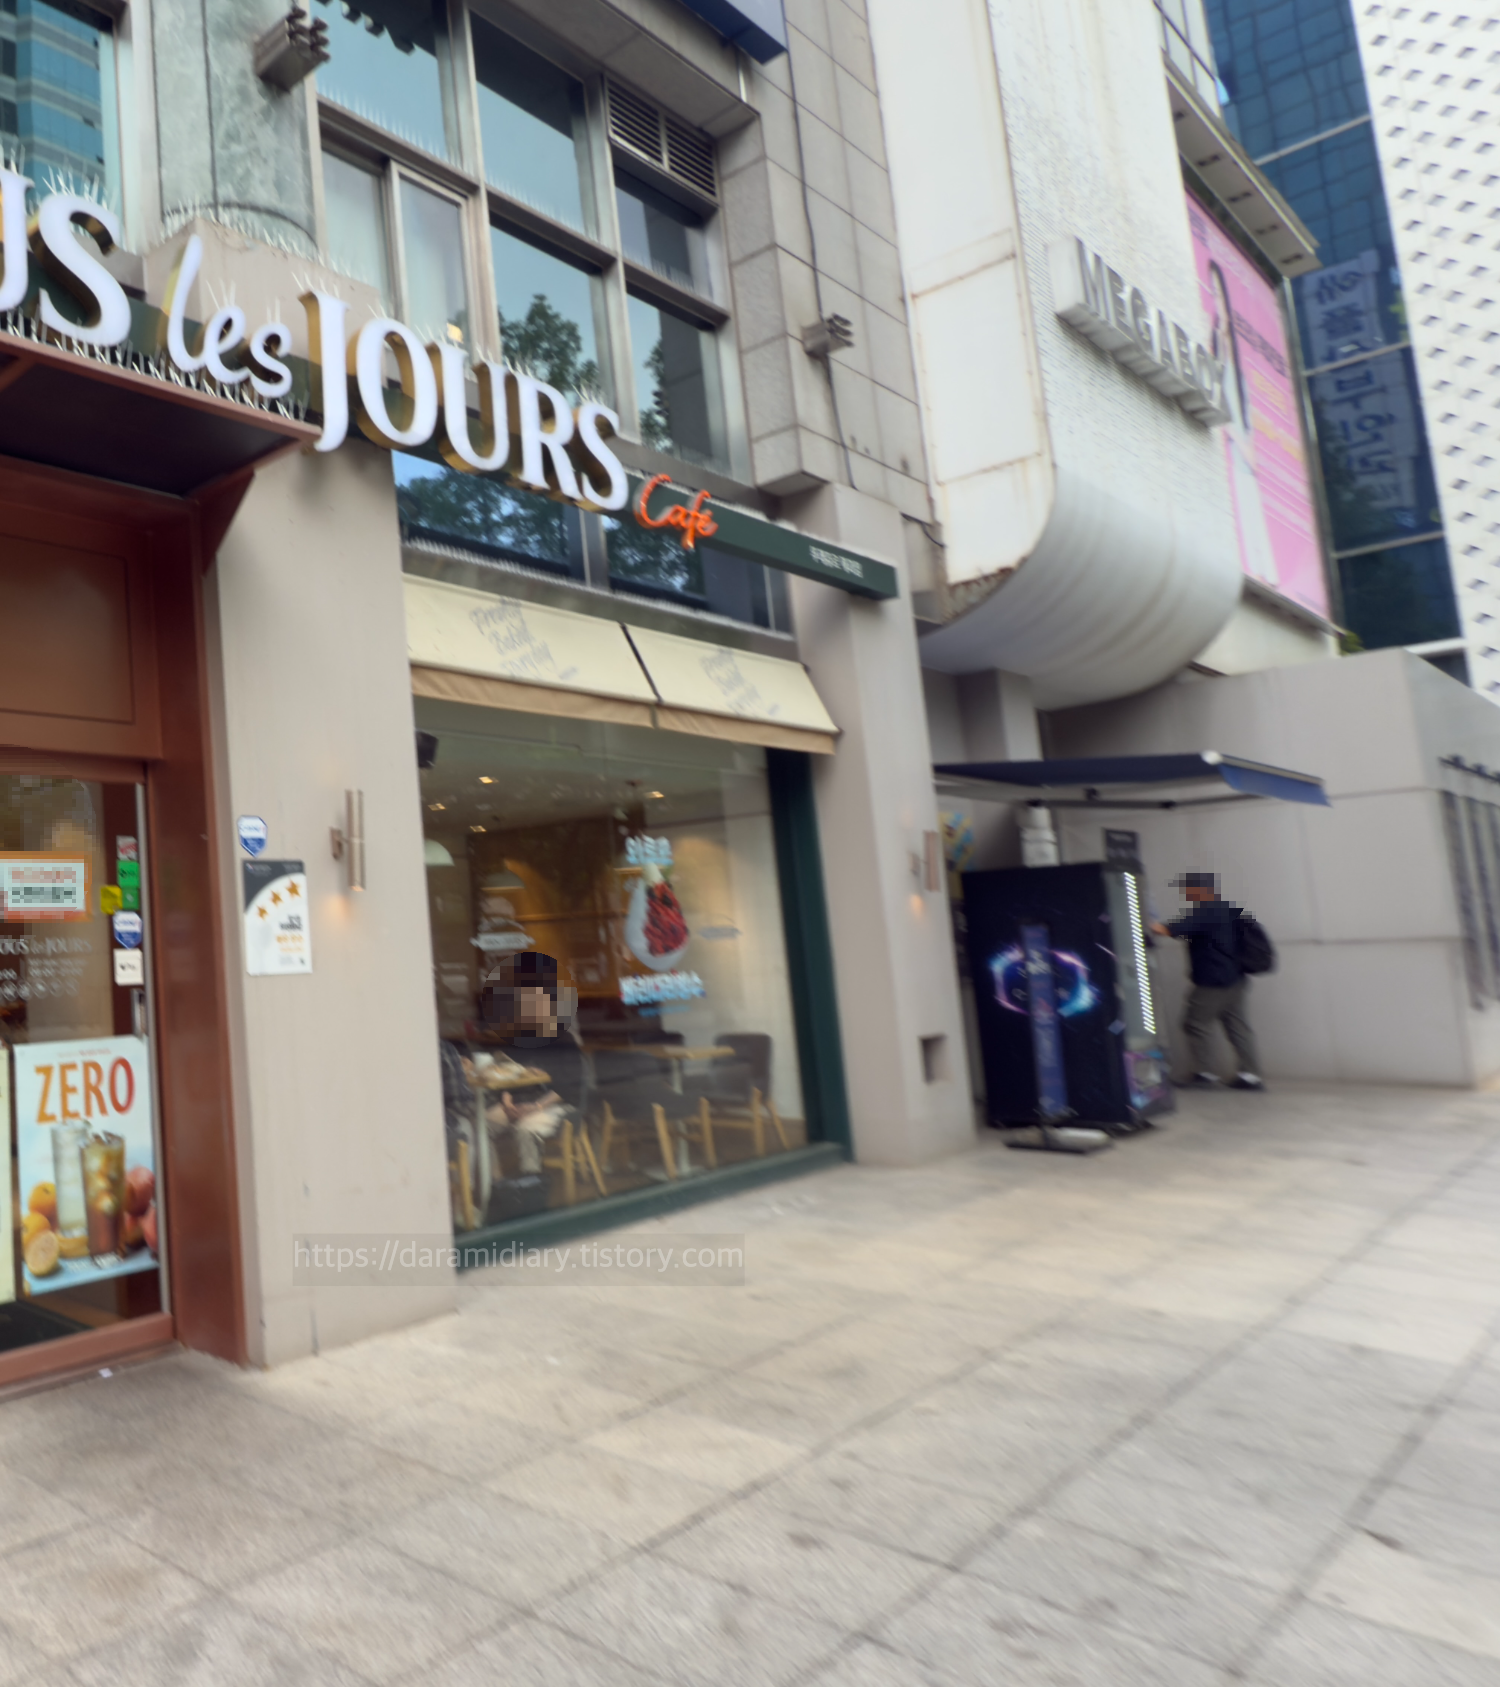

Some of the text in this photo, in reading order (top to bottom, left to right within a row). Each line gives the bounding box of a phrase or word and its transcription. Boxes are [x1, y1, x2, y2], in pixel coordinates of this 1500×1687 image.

[164, 230, 293, 397] les
[298, 291, 630, 511] JOURS
[34, 1057, 135, 1124] ZERO
